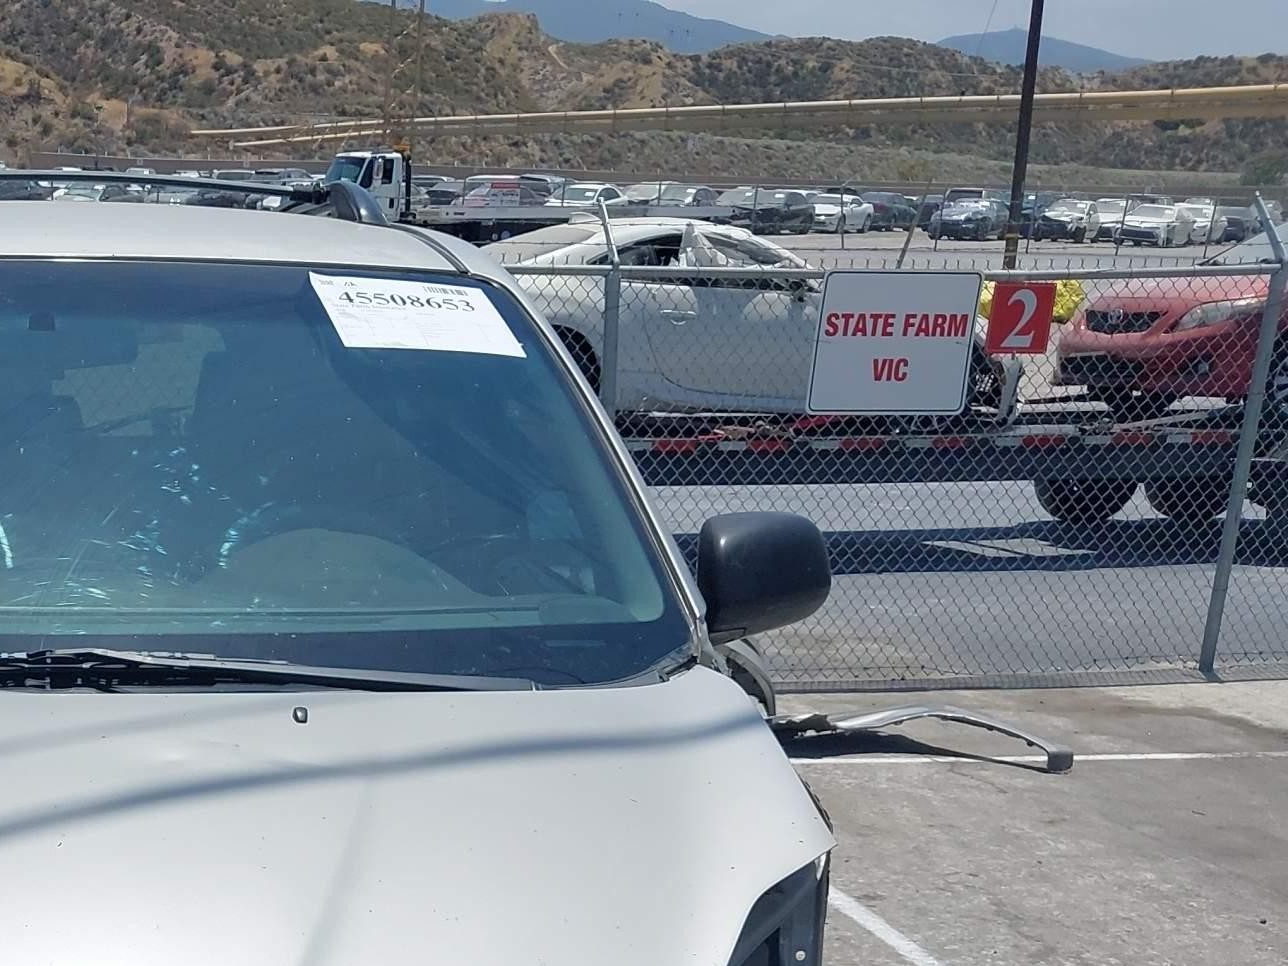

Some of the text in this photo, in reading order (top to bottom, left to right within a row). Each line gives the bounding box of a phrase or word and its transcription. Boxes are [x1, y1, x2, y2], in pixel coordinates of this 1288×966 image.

[339, 291, 475, 312] 45508653
[824, 312, 969, 337] STATE FARM
[1000, 288, 1038, 348] 2
[872, 358, 909, 382] VIC
